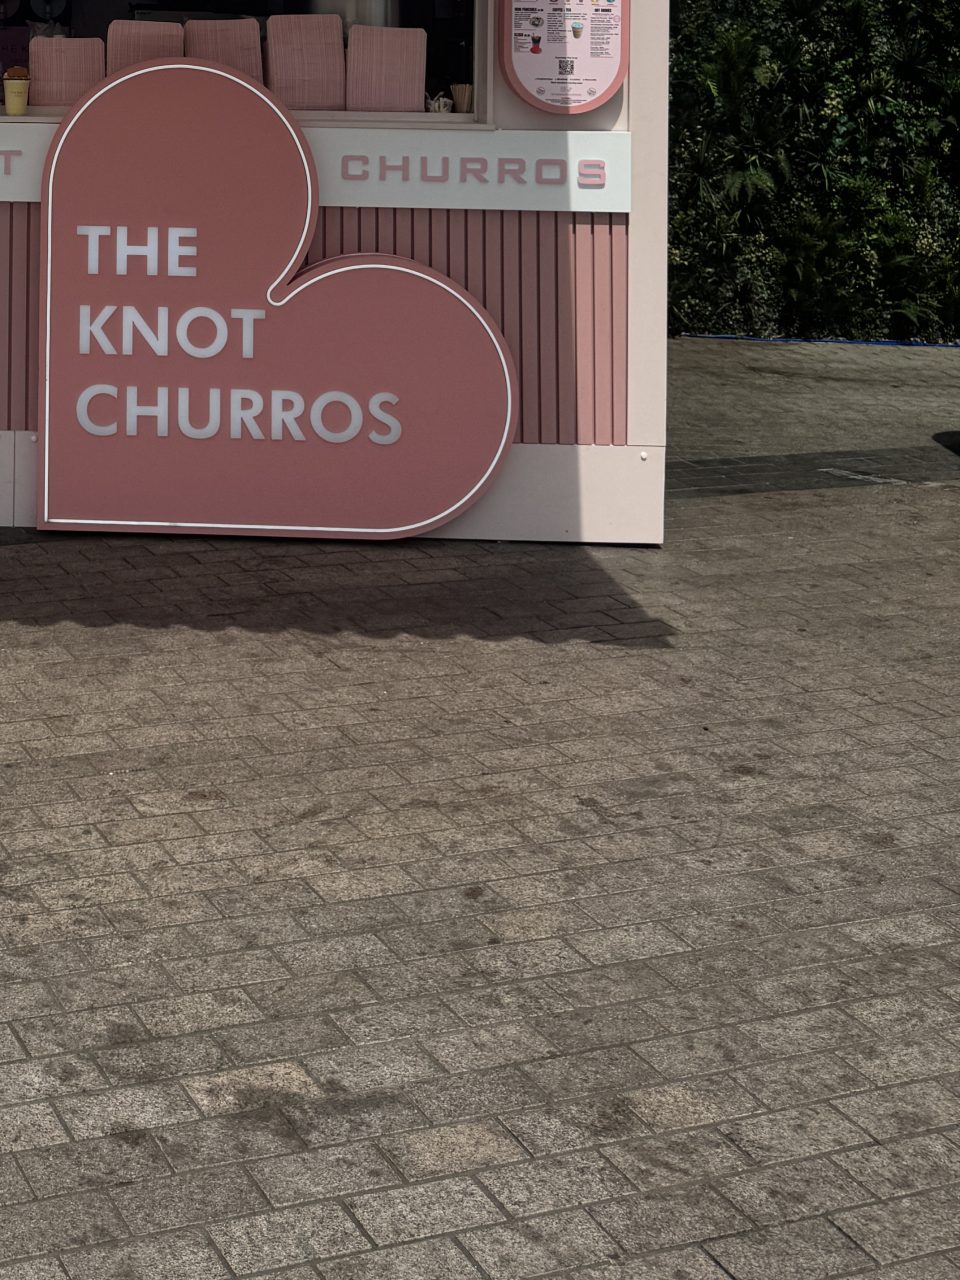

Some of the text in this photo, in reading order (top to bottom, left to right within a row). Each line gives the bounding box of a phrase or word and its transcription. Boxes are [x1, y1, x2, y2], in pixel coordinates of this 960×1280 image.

[341, 154, 607, 189] CHURROS
[76, 225, 199, 277] THE
[77, 304, 266, 359] KNOT
[75, 383, 403, 445] CHURROS
